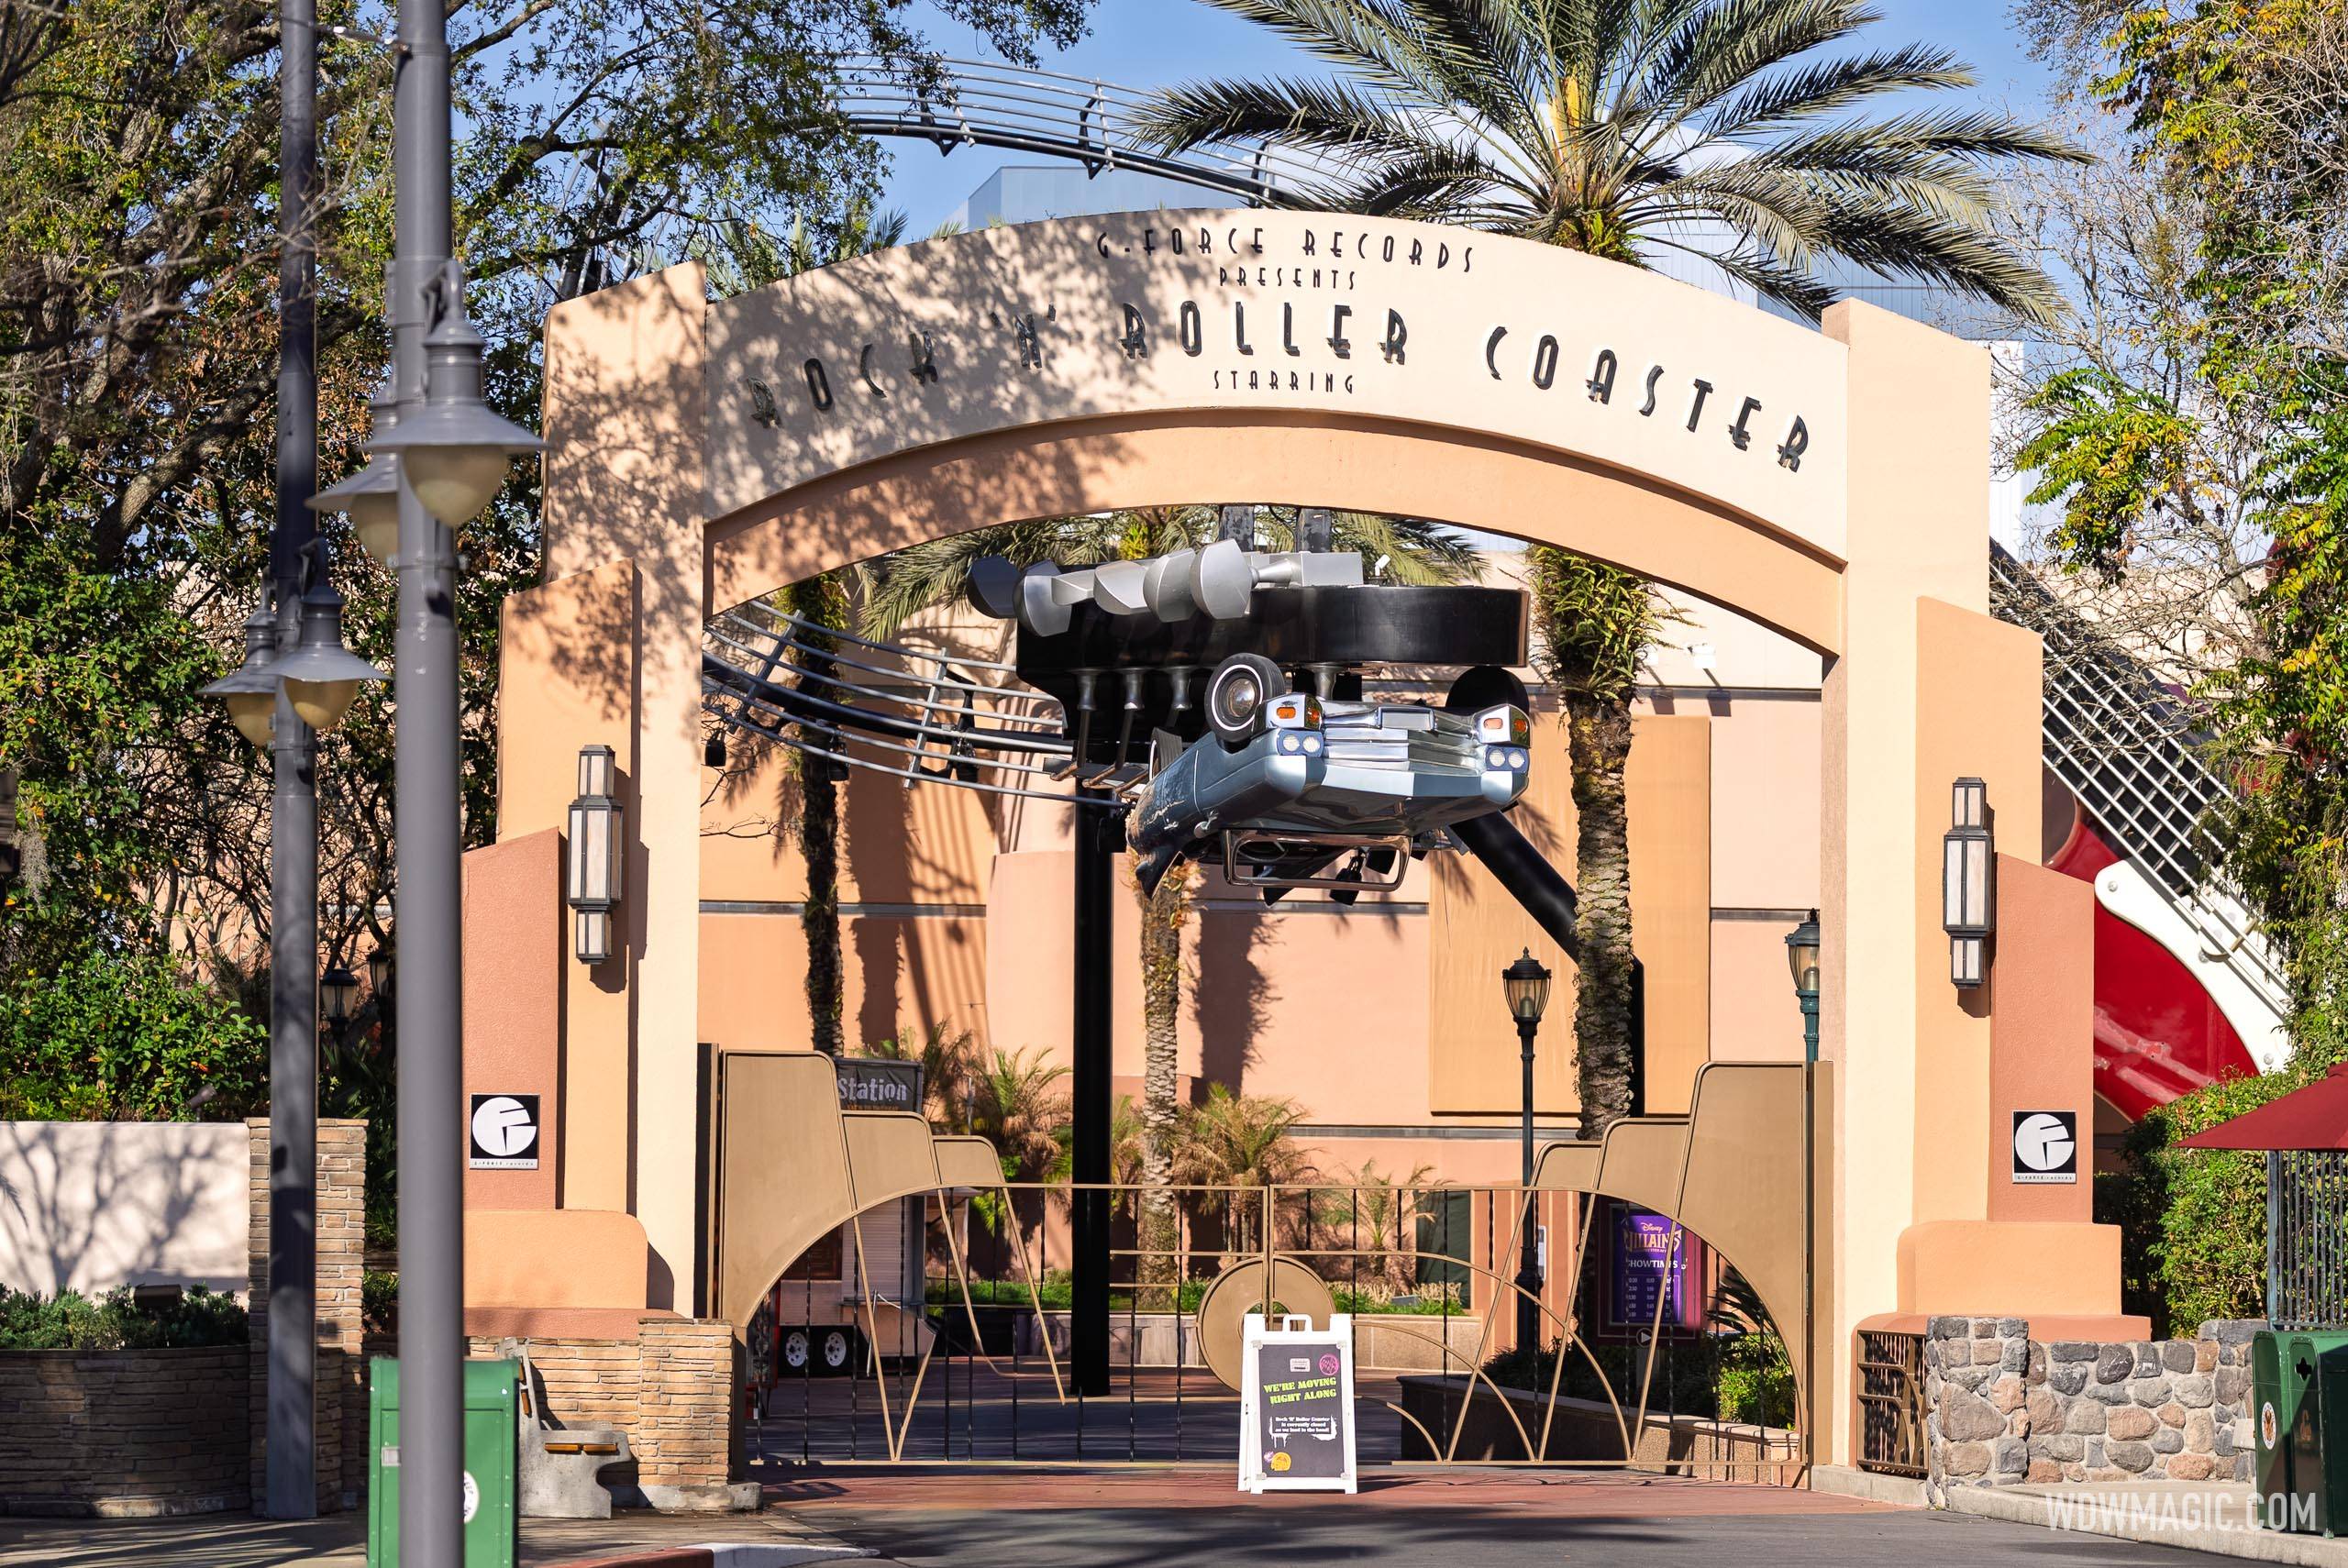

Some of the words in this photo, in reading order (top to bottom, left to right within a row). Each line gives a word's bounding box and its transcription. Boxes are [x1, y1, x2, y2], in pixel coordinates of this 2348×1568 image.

[1301, 228, 1473, 273] RECORDS
[1219, 266, 1356, 291] PRESENTS
[745, 329, 939, 429] ROCK
[1118, 300, 1408, 366] ROLLER
[1485, 326, 1810, 473] COASTER
[1213, 370, 1355, 395] STARRING
[837, 1077, 908, 1102] Station
[1263, 1382, 1295, 1393] WE'RE
[1298, 1377, 1337, 1389] MOVING
[1269, 1393, 1301, 1404] RIGHT
[1304, 1389, 1337, 1400] ALONG
